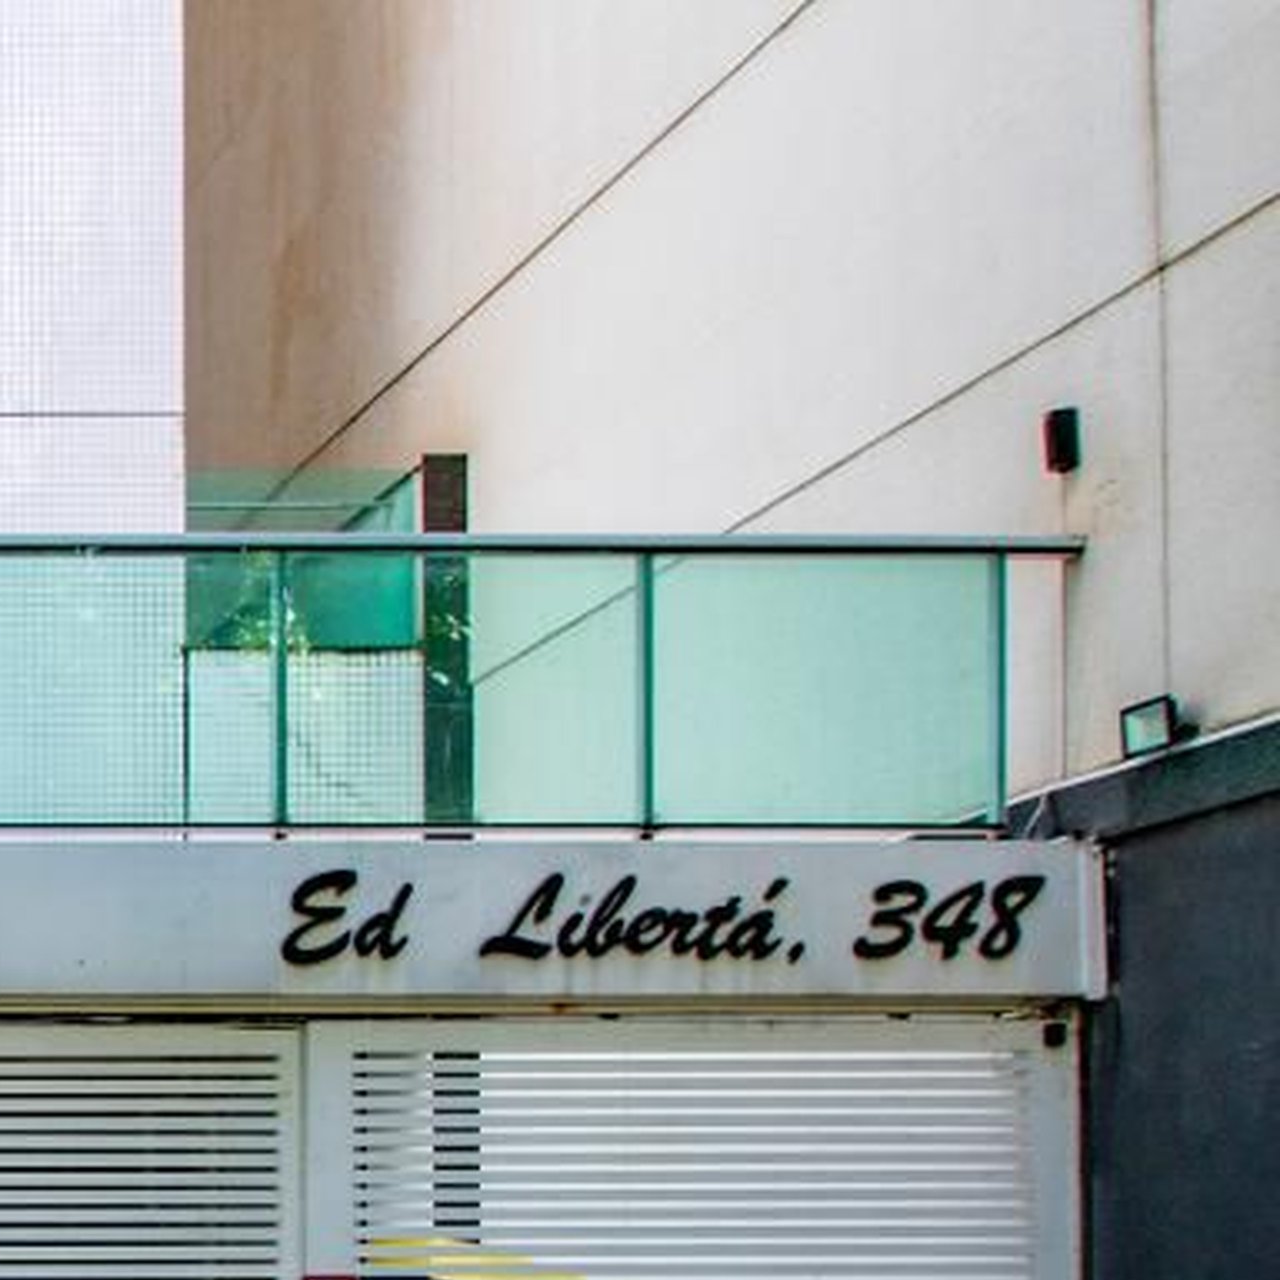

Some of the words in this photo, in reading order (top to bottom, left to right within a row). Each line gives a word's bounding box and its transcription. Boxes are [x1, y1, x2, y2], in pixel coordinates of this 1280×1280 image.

[281, 869, 414, 967] Ed
[478, 872, 806, 965] Libertá,
[852, 875, 1047, 962] 348
